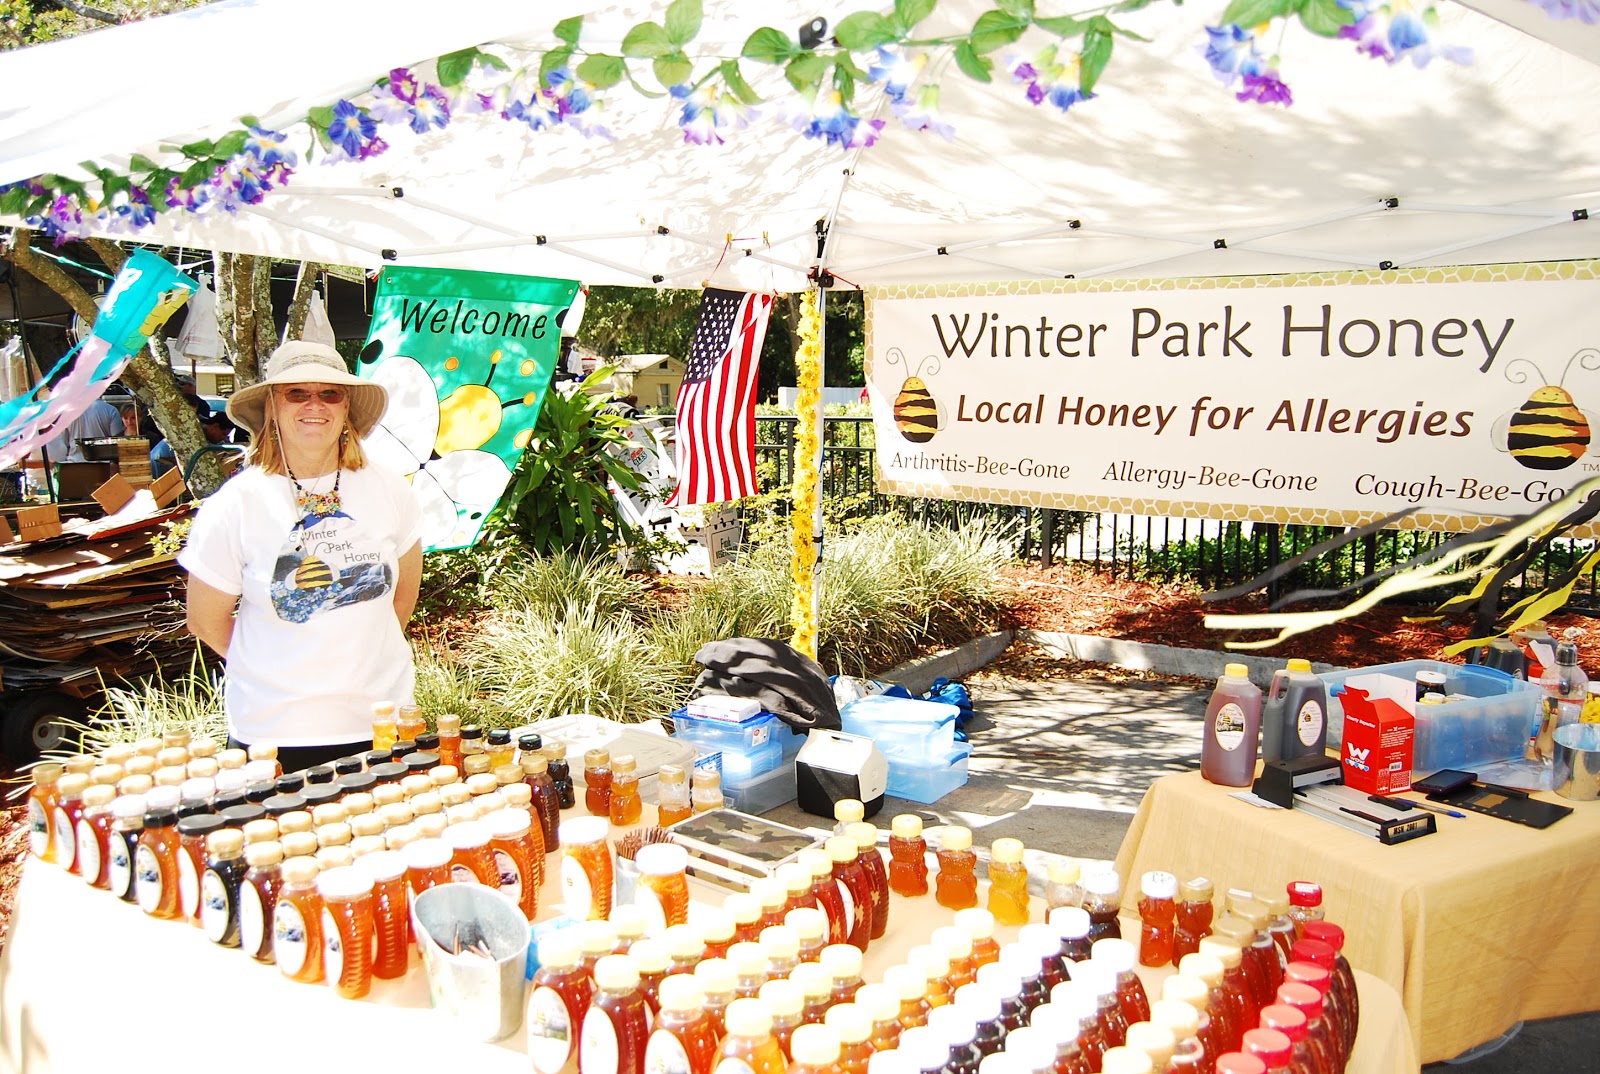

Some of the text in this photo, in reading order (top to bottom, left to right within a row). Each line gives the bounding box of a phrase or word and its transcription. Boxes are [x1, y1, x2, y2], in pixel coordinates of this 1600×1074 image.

[400, 298, 548, 339] Welcome
[931, 304, 1515, 374] Winter Park Honey
[957, 394, 1475, 444] Local Honey for Allergies
[890, 451, 1600, 504] Arthritis-Bee-Gone Allergy-Bee-Gone Cough-Bee-Go
[300, 529, 338, 541] Winter
[328, 541, 354, 552] Park
[343, 552, 381, 564] Honey
